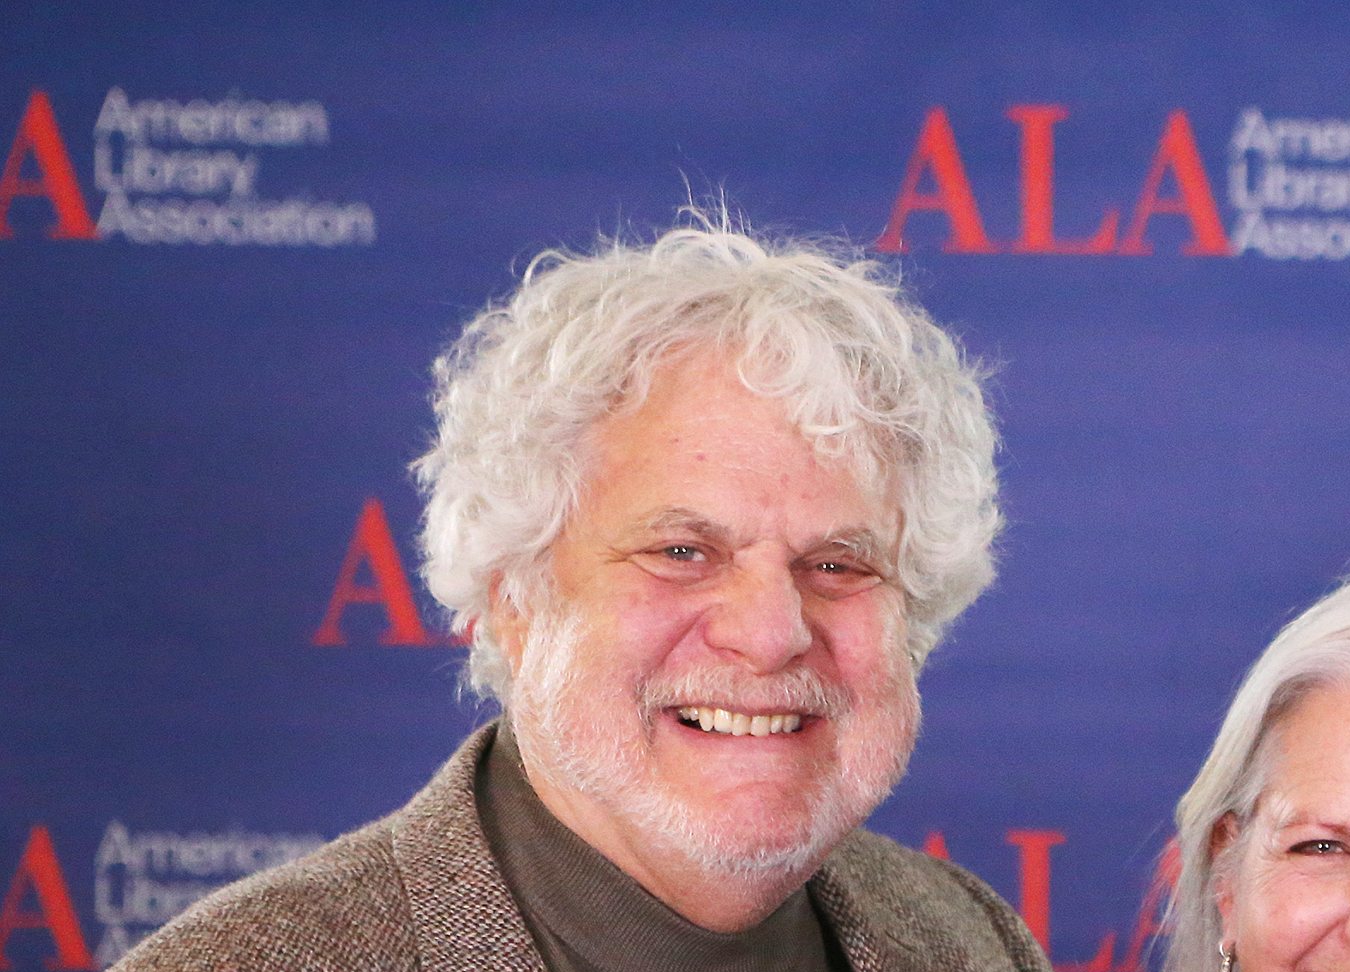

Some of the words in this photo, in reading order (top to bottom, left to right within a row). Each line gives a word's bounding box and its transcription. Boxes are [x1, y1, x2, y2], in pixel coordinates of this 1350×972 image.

[94, 86, 330, 147] American
[94, 146, 258, 203] Library
[876, 105, 1236, 256] ALA
[96, 187, 376, 247] Association
